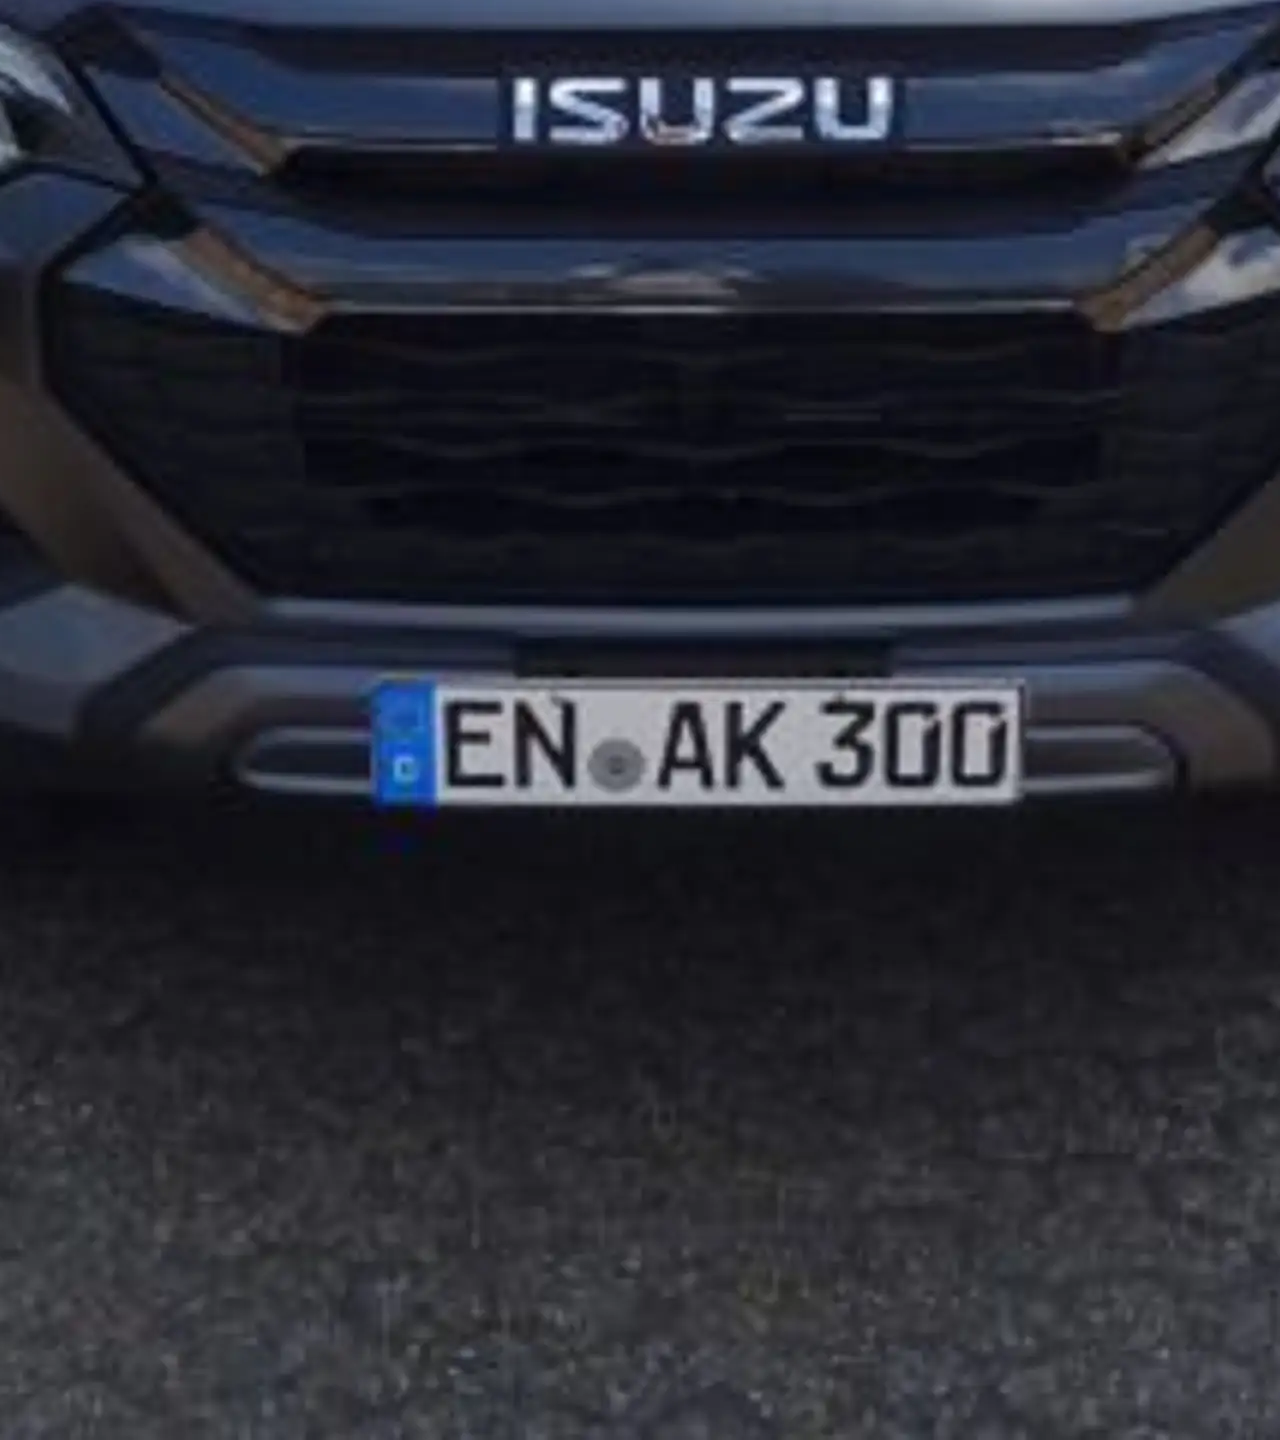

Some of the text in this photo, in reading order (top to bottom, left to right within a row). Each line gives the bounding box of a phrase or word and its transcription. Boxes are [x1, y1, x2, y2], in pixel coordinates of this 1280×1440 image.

[513, 77, 893, 144] ISUZU
[444, 701, 577, 788] EN
[657, 701, 785, 789] AK
[815, 701, 1009, 789] 300
